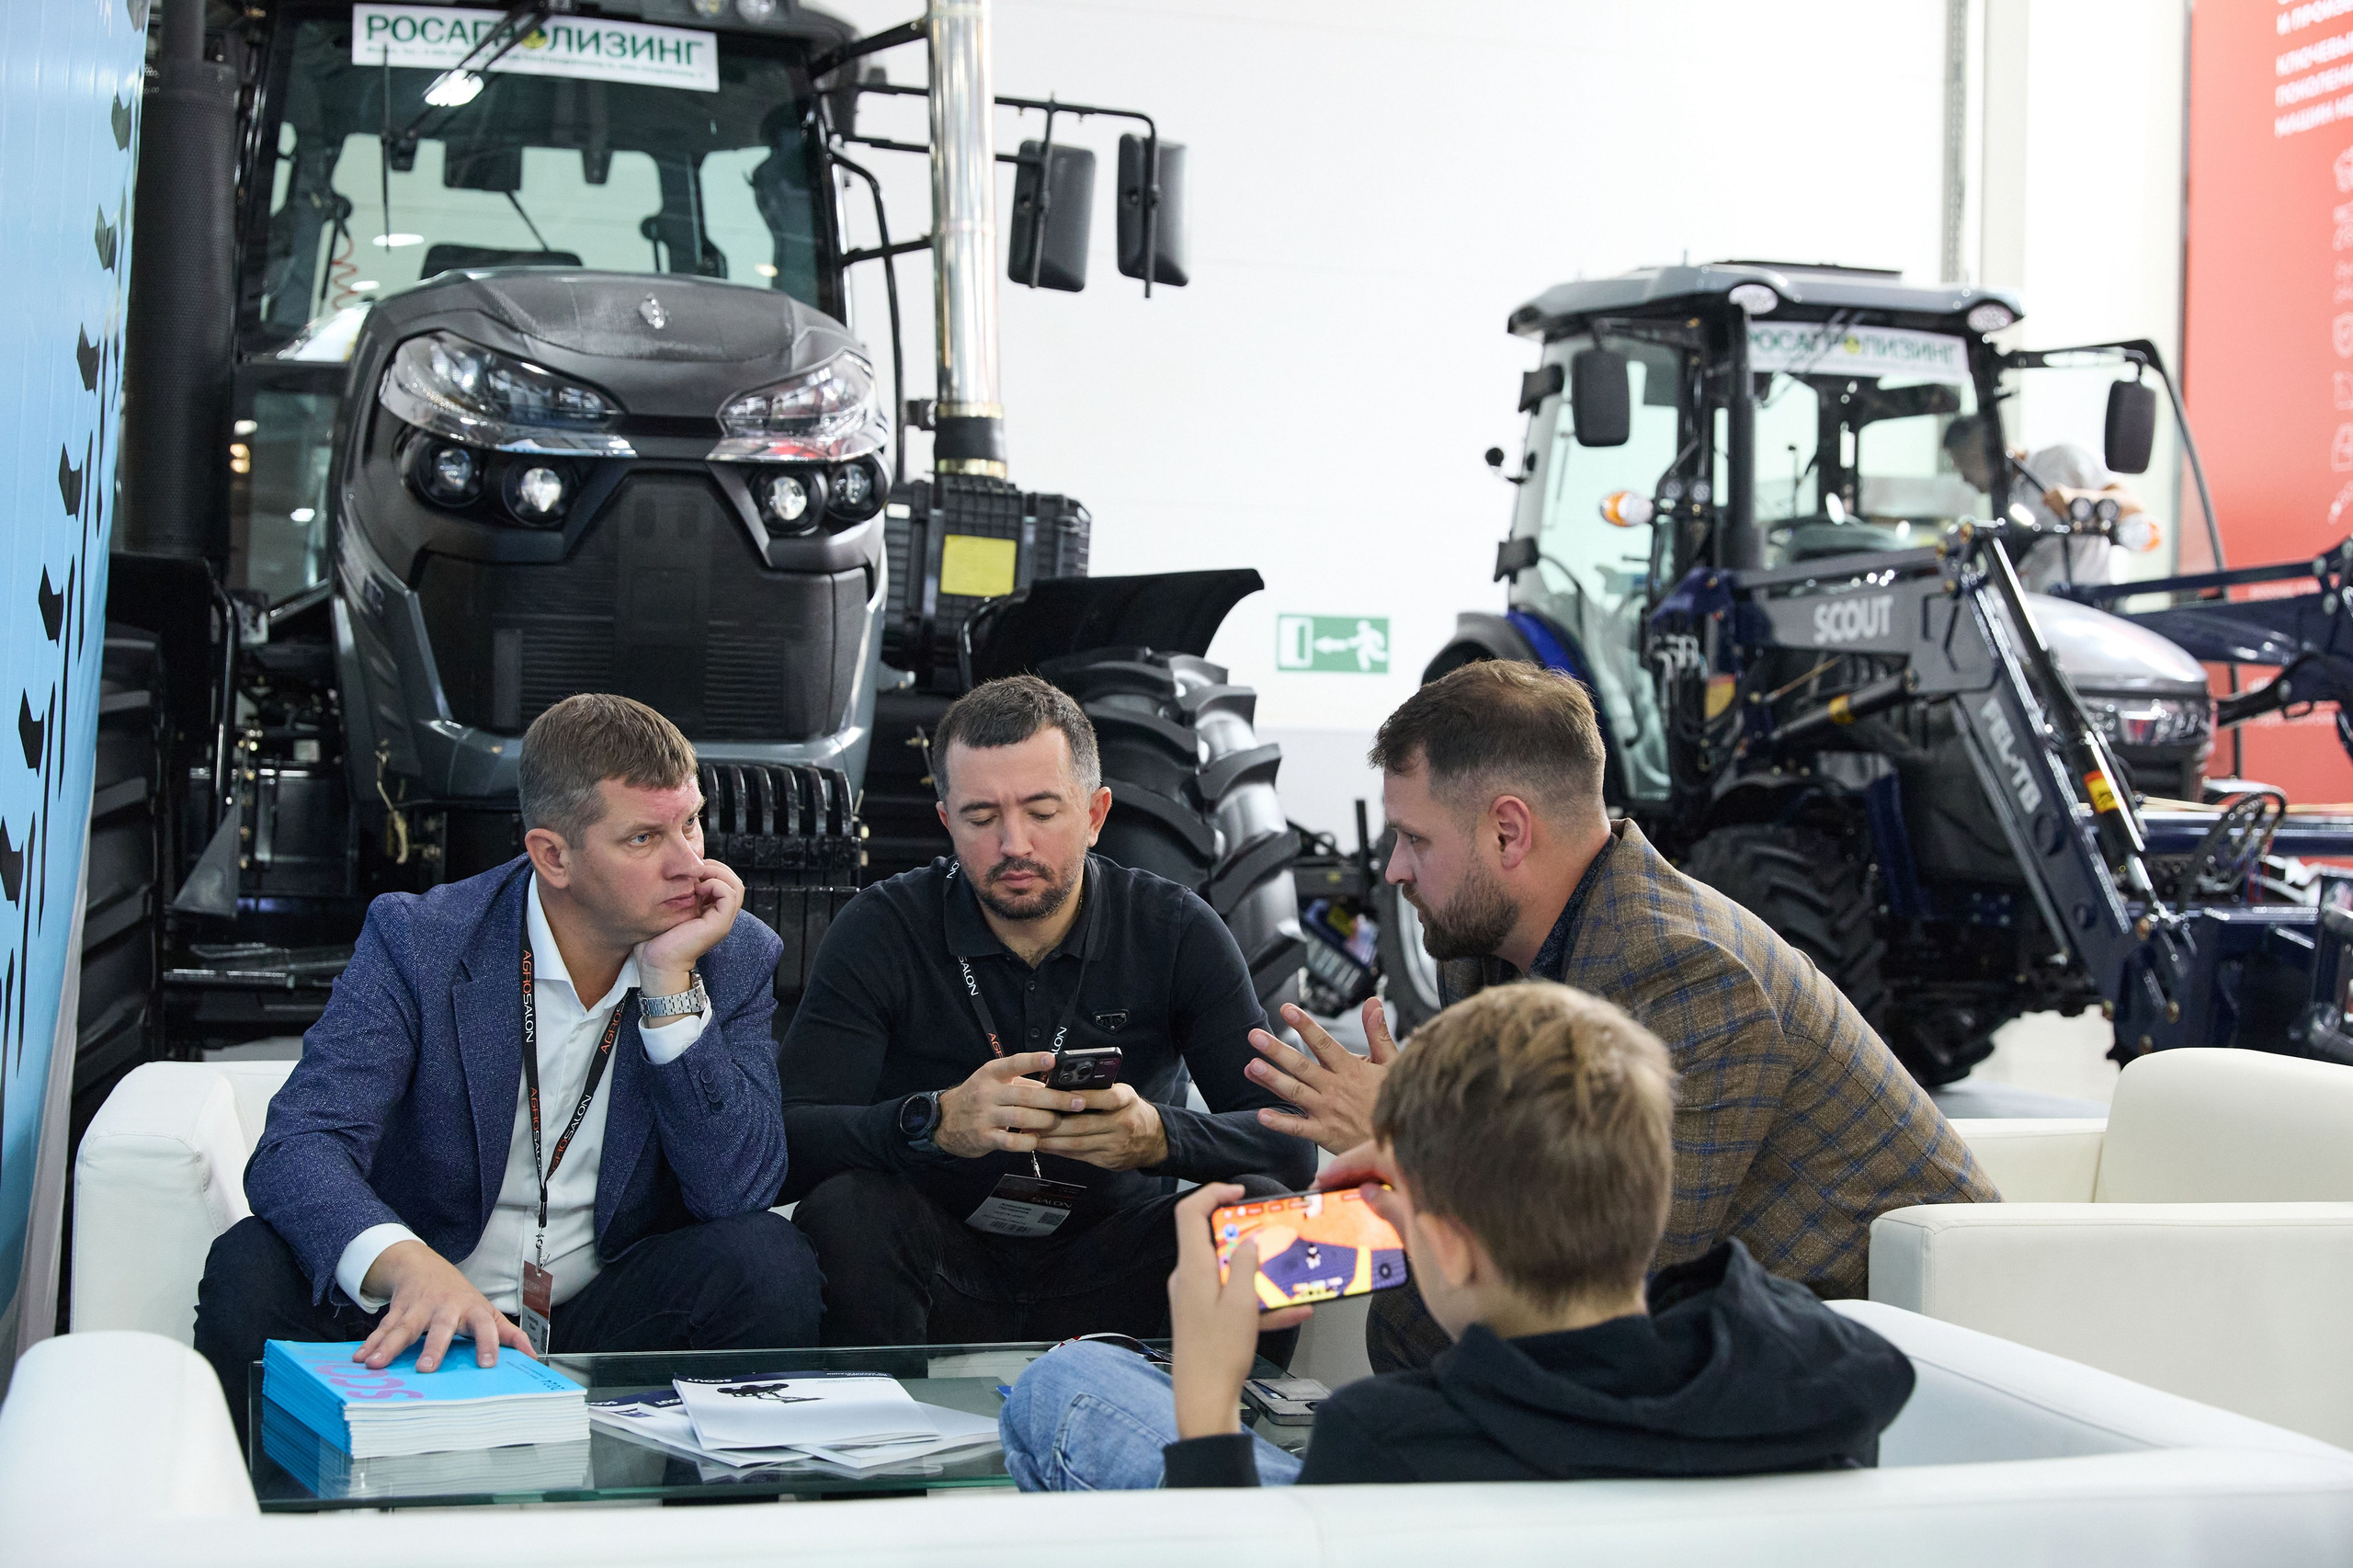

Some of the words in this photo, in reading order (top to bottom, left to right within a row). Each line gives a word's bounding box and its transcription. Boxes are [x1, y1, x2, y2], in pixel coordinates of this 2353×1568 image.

[1813, 595, 1893, 643] SCOUT
[522, 949, 534, 1043] AGROSALON
[303, 1359, 425, 1400] SCO
